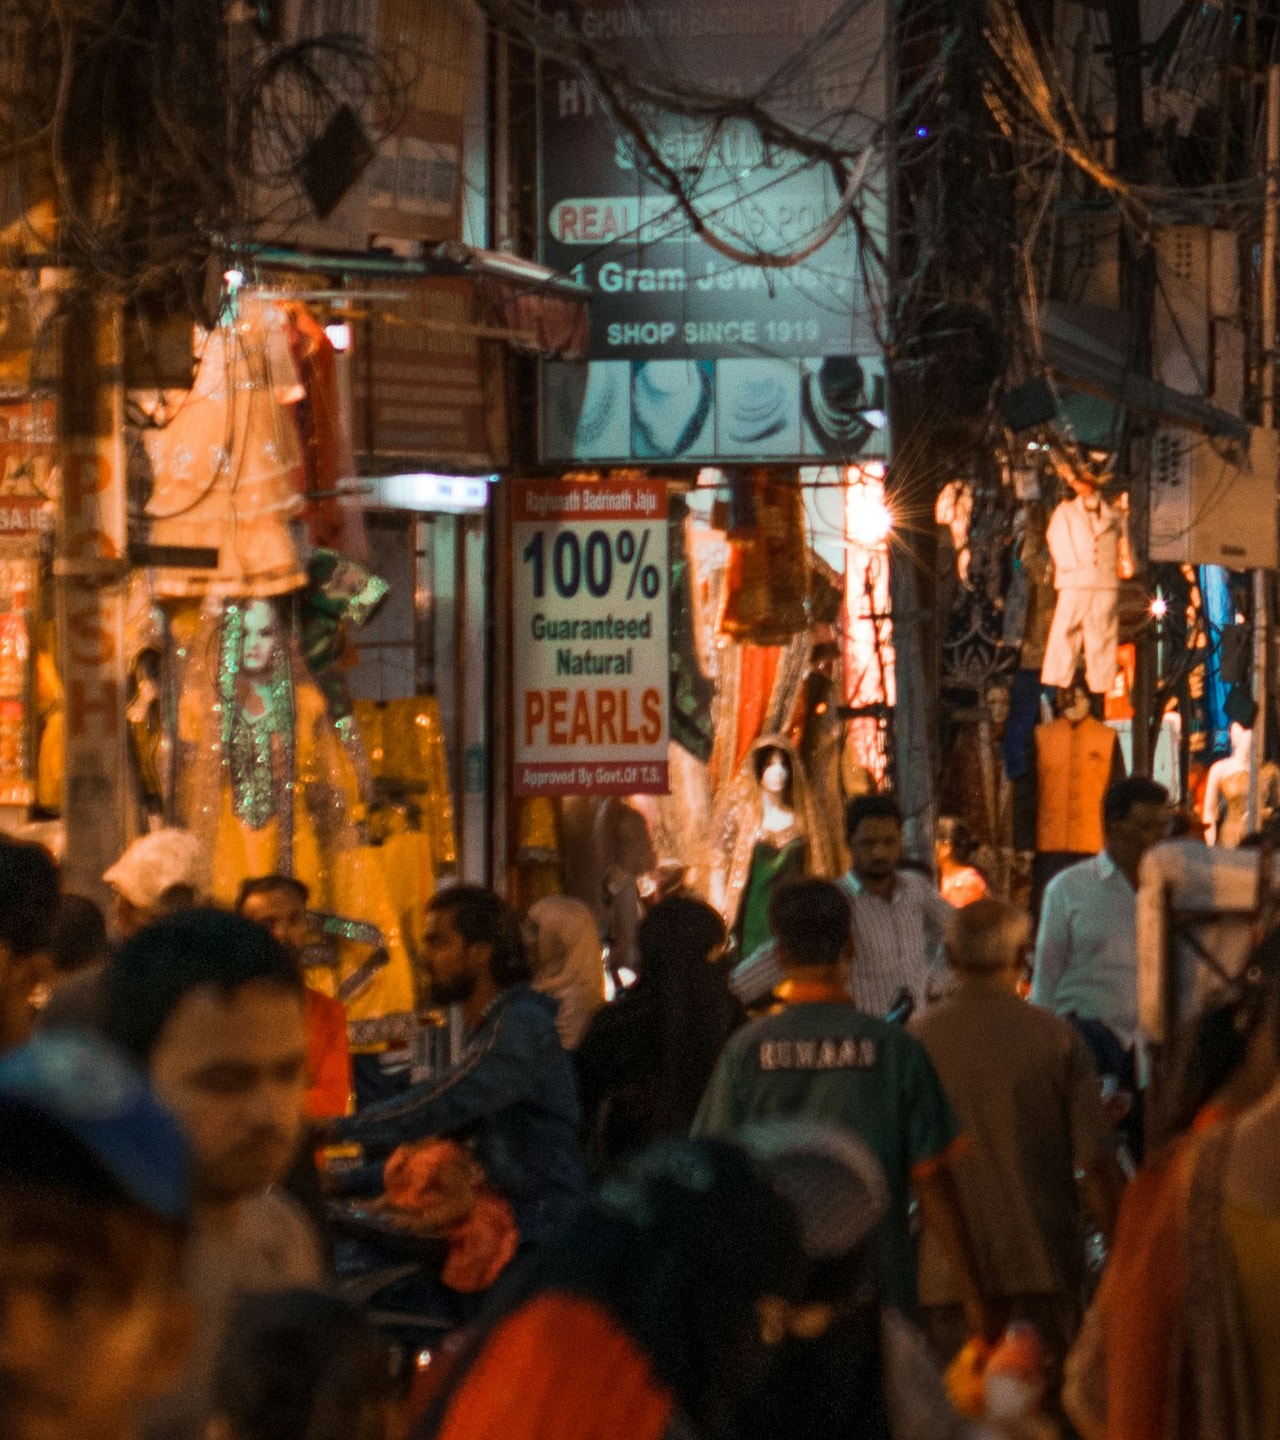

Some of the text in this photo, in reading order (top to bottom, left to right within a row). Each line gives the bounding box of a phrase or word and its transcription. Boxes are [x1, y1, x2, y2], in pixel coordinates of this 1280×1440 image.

[557, 205, 632, 244] REAL
[596, 261, 686, 293] Gram
[605, 320, 677, 347] SHOP
[684, 318, 757, 347] SINCE
[523, 529, 661, 602] 100%
[531, 612, 652, 641] Guaranteed
[556, 649, 632, 675] Natural
[524, 688, 663, 747] PEARLS
